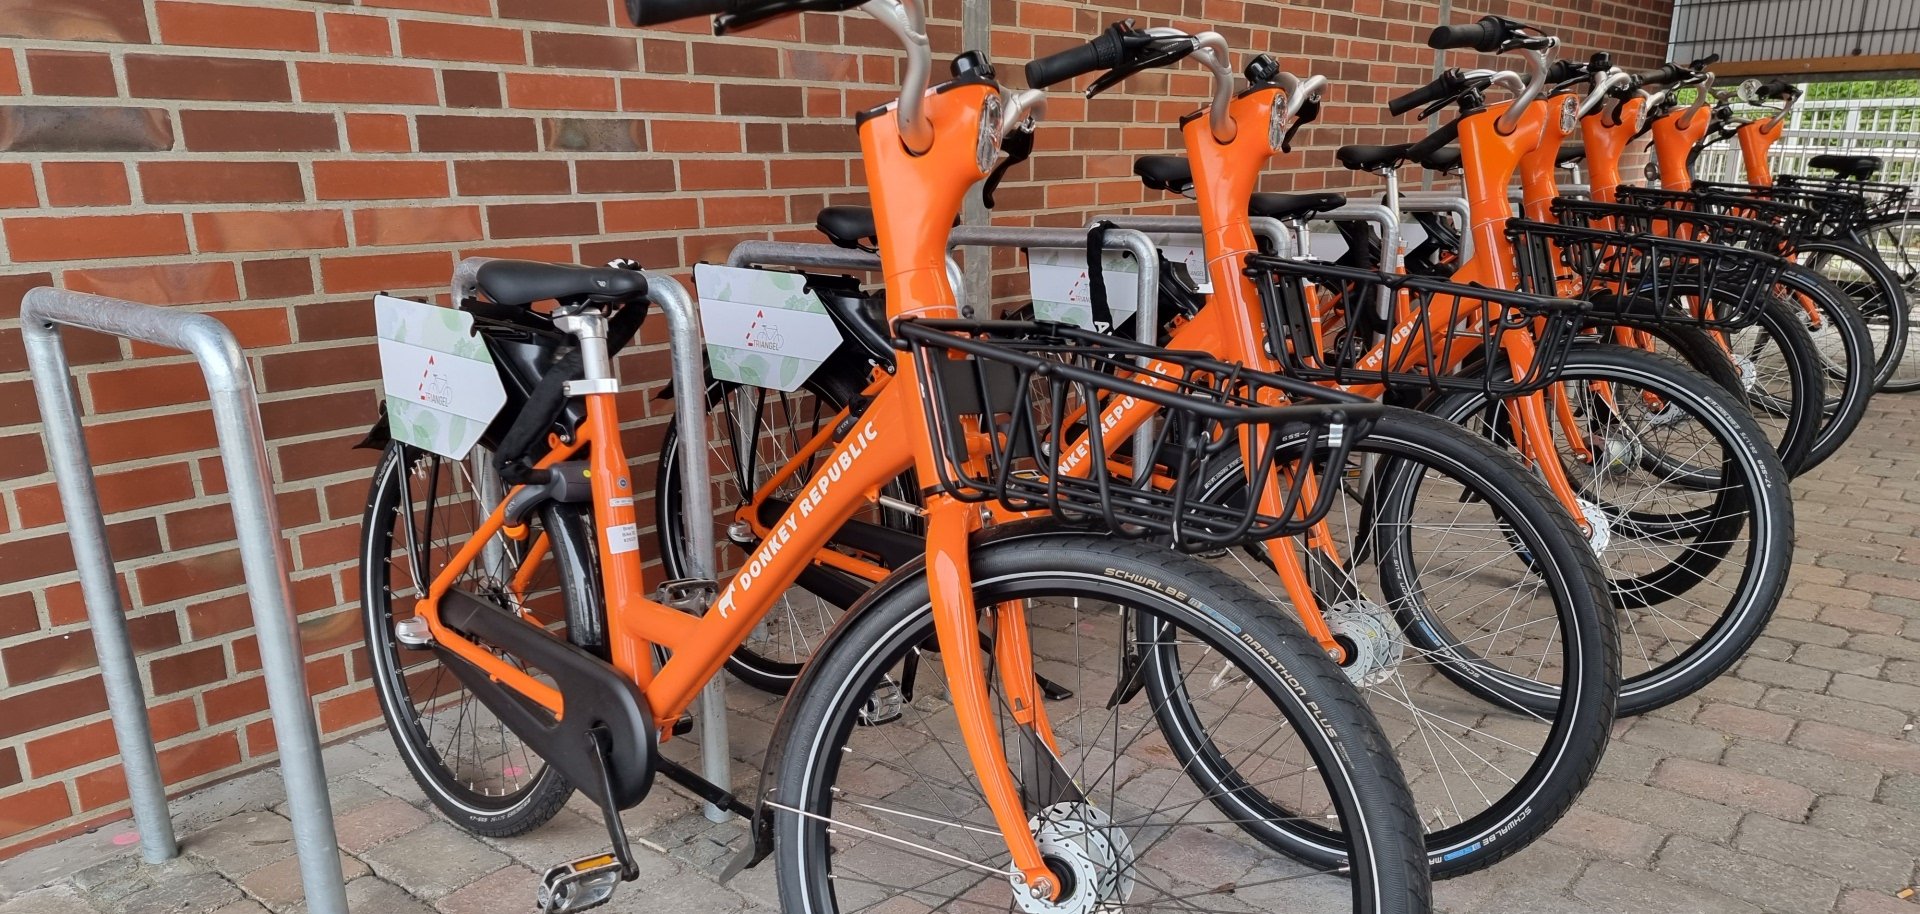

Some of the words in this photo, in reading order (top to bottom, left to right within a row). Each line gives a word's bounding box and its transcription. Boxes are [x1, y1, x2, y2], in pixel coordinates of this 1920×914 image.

[752, 339, 780, 351] TRIANGEL
[739, 512, 799, 591] DONKEY
[798, 420, 878, 518] REPUBLIC
[1103, 567, 1188, 601] SCHWALBE
[1241, 633, 1307, 696] MARATHON
[1306, 701, 1338, 738] PLUS
[1482, 805, 1532, 847] SCHWALBE
